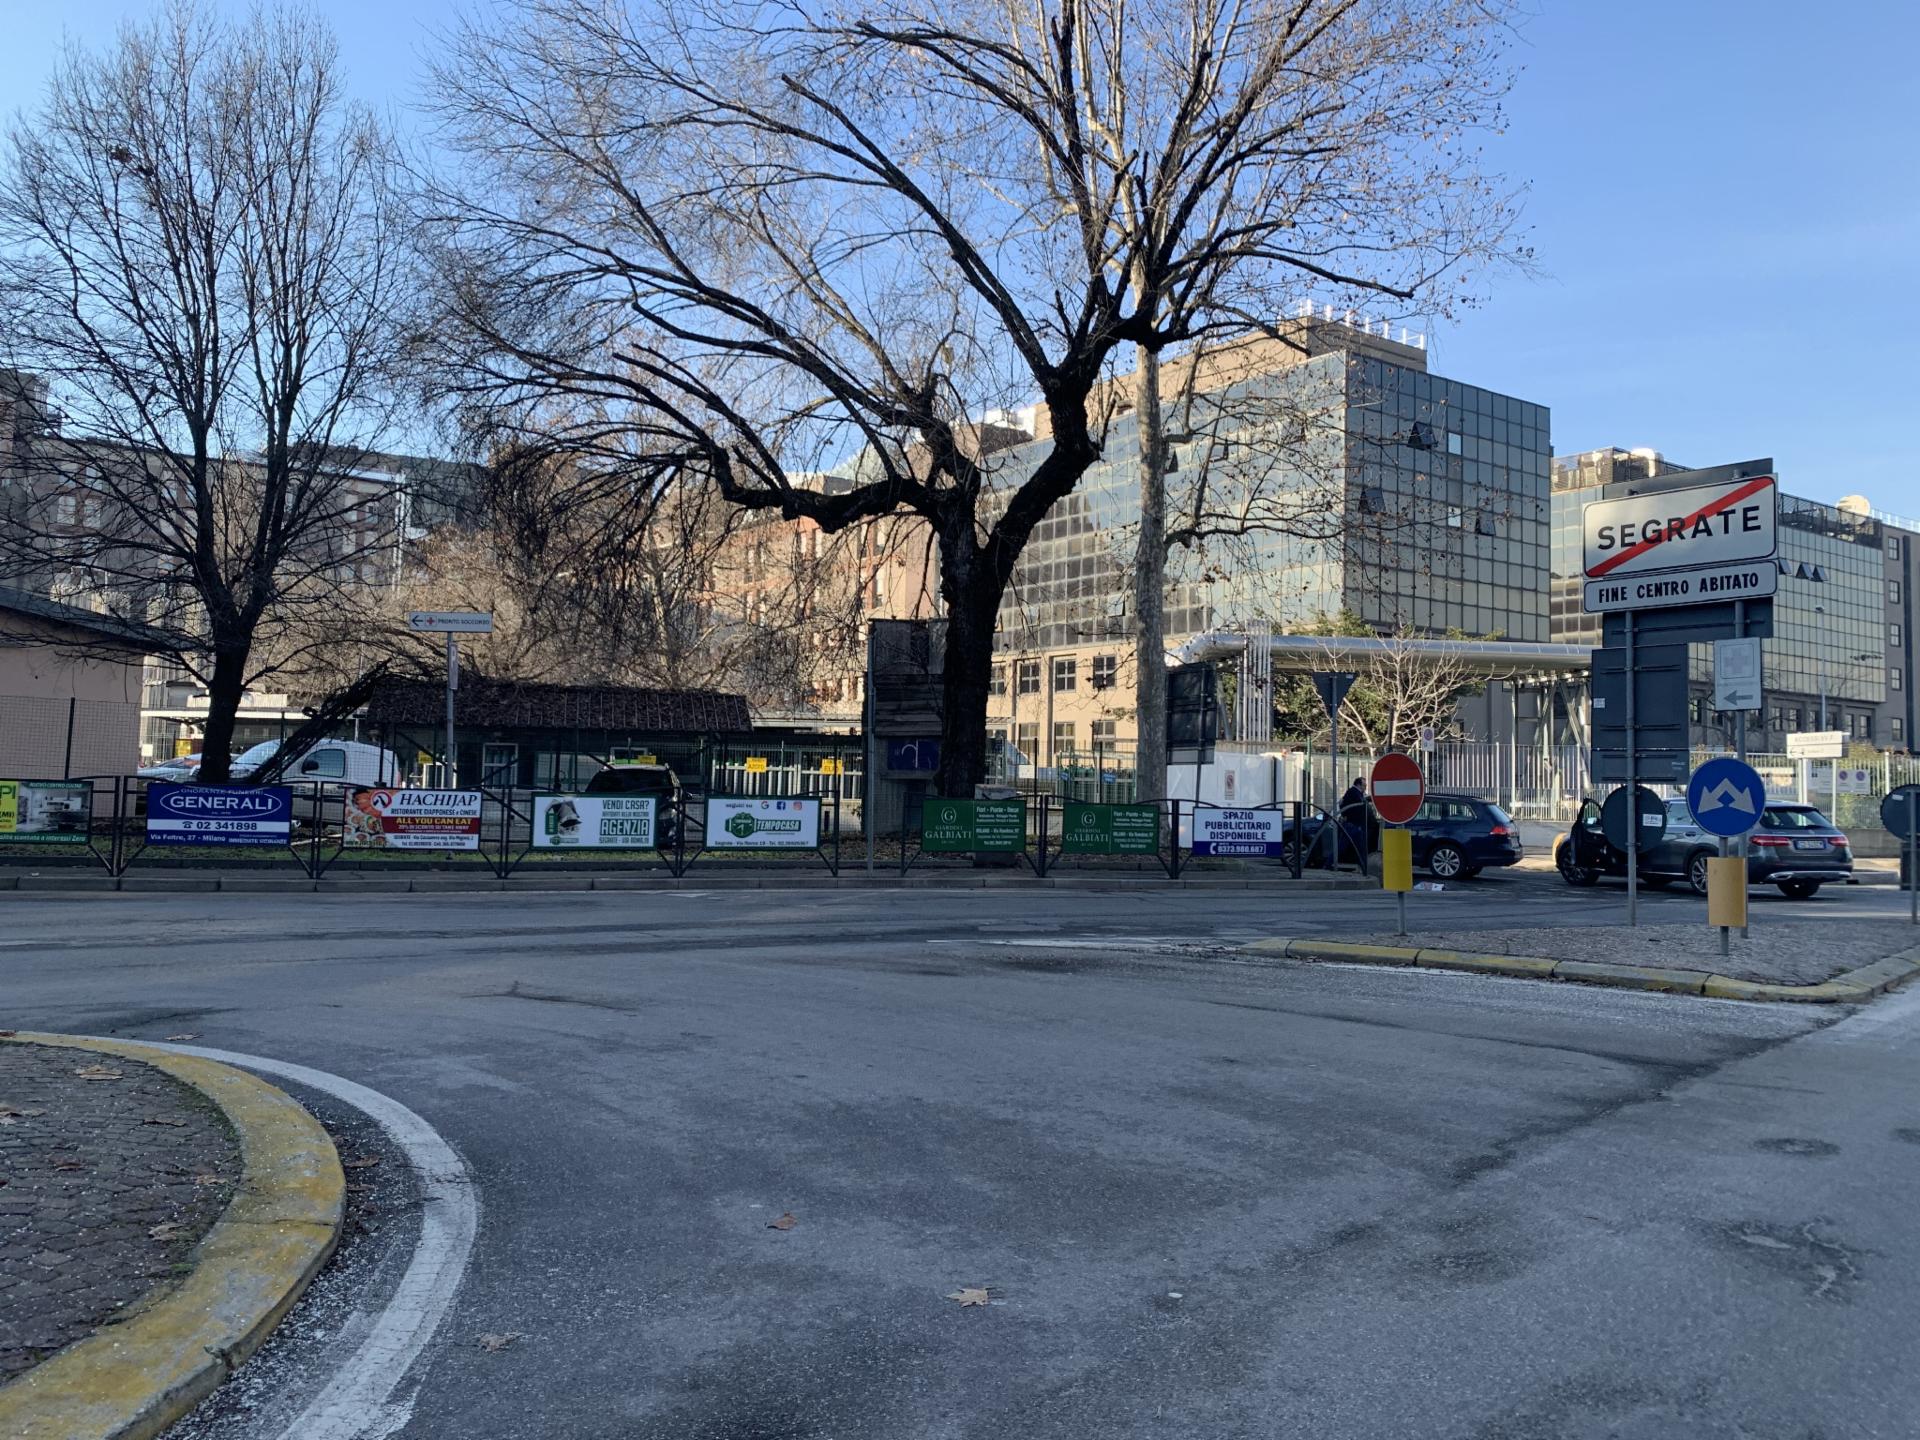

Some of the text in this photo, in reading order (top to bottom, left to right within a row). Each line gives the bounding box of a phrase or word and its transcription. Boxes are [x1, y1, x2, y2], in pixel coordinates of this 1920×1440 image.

[1597, 505, 1762, 550] SEGRATE
[1598, 572, 1759, 604] FINE CENTRO ABITATO
[169, 795, 273, 811] GENERALI
[399, 793, 478, 808] HACHIJAP
[602, 800, 650, 810] VENDI CASA?
[1222, 811, 1254, 820] SPAZIO
[196, 821, 258, 831] 02 341898
[396, 817, 414, 825] ALL
[415, 817, 433, 825] YOU
[756, 820, 800, 831] TEMPOCASA
[1204, 821, 1272, 831] PUBBLICITARIO
[601, 820, 649, 835] AGENZIA
[924, 831, 972, 840] GALBIATI
[1065, 832, 1109, 843] GALBIATI
[1209, 831, 1267, 841] DISPONIBILE
